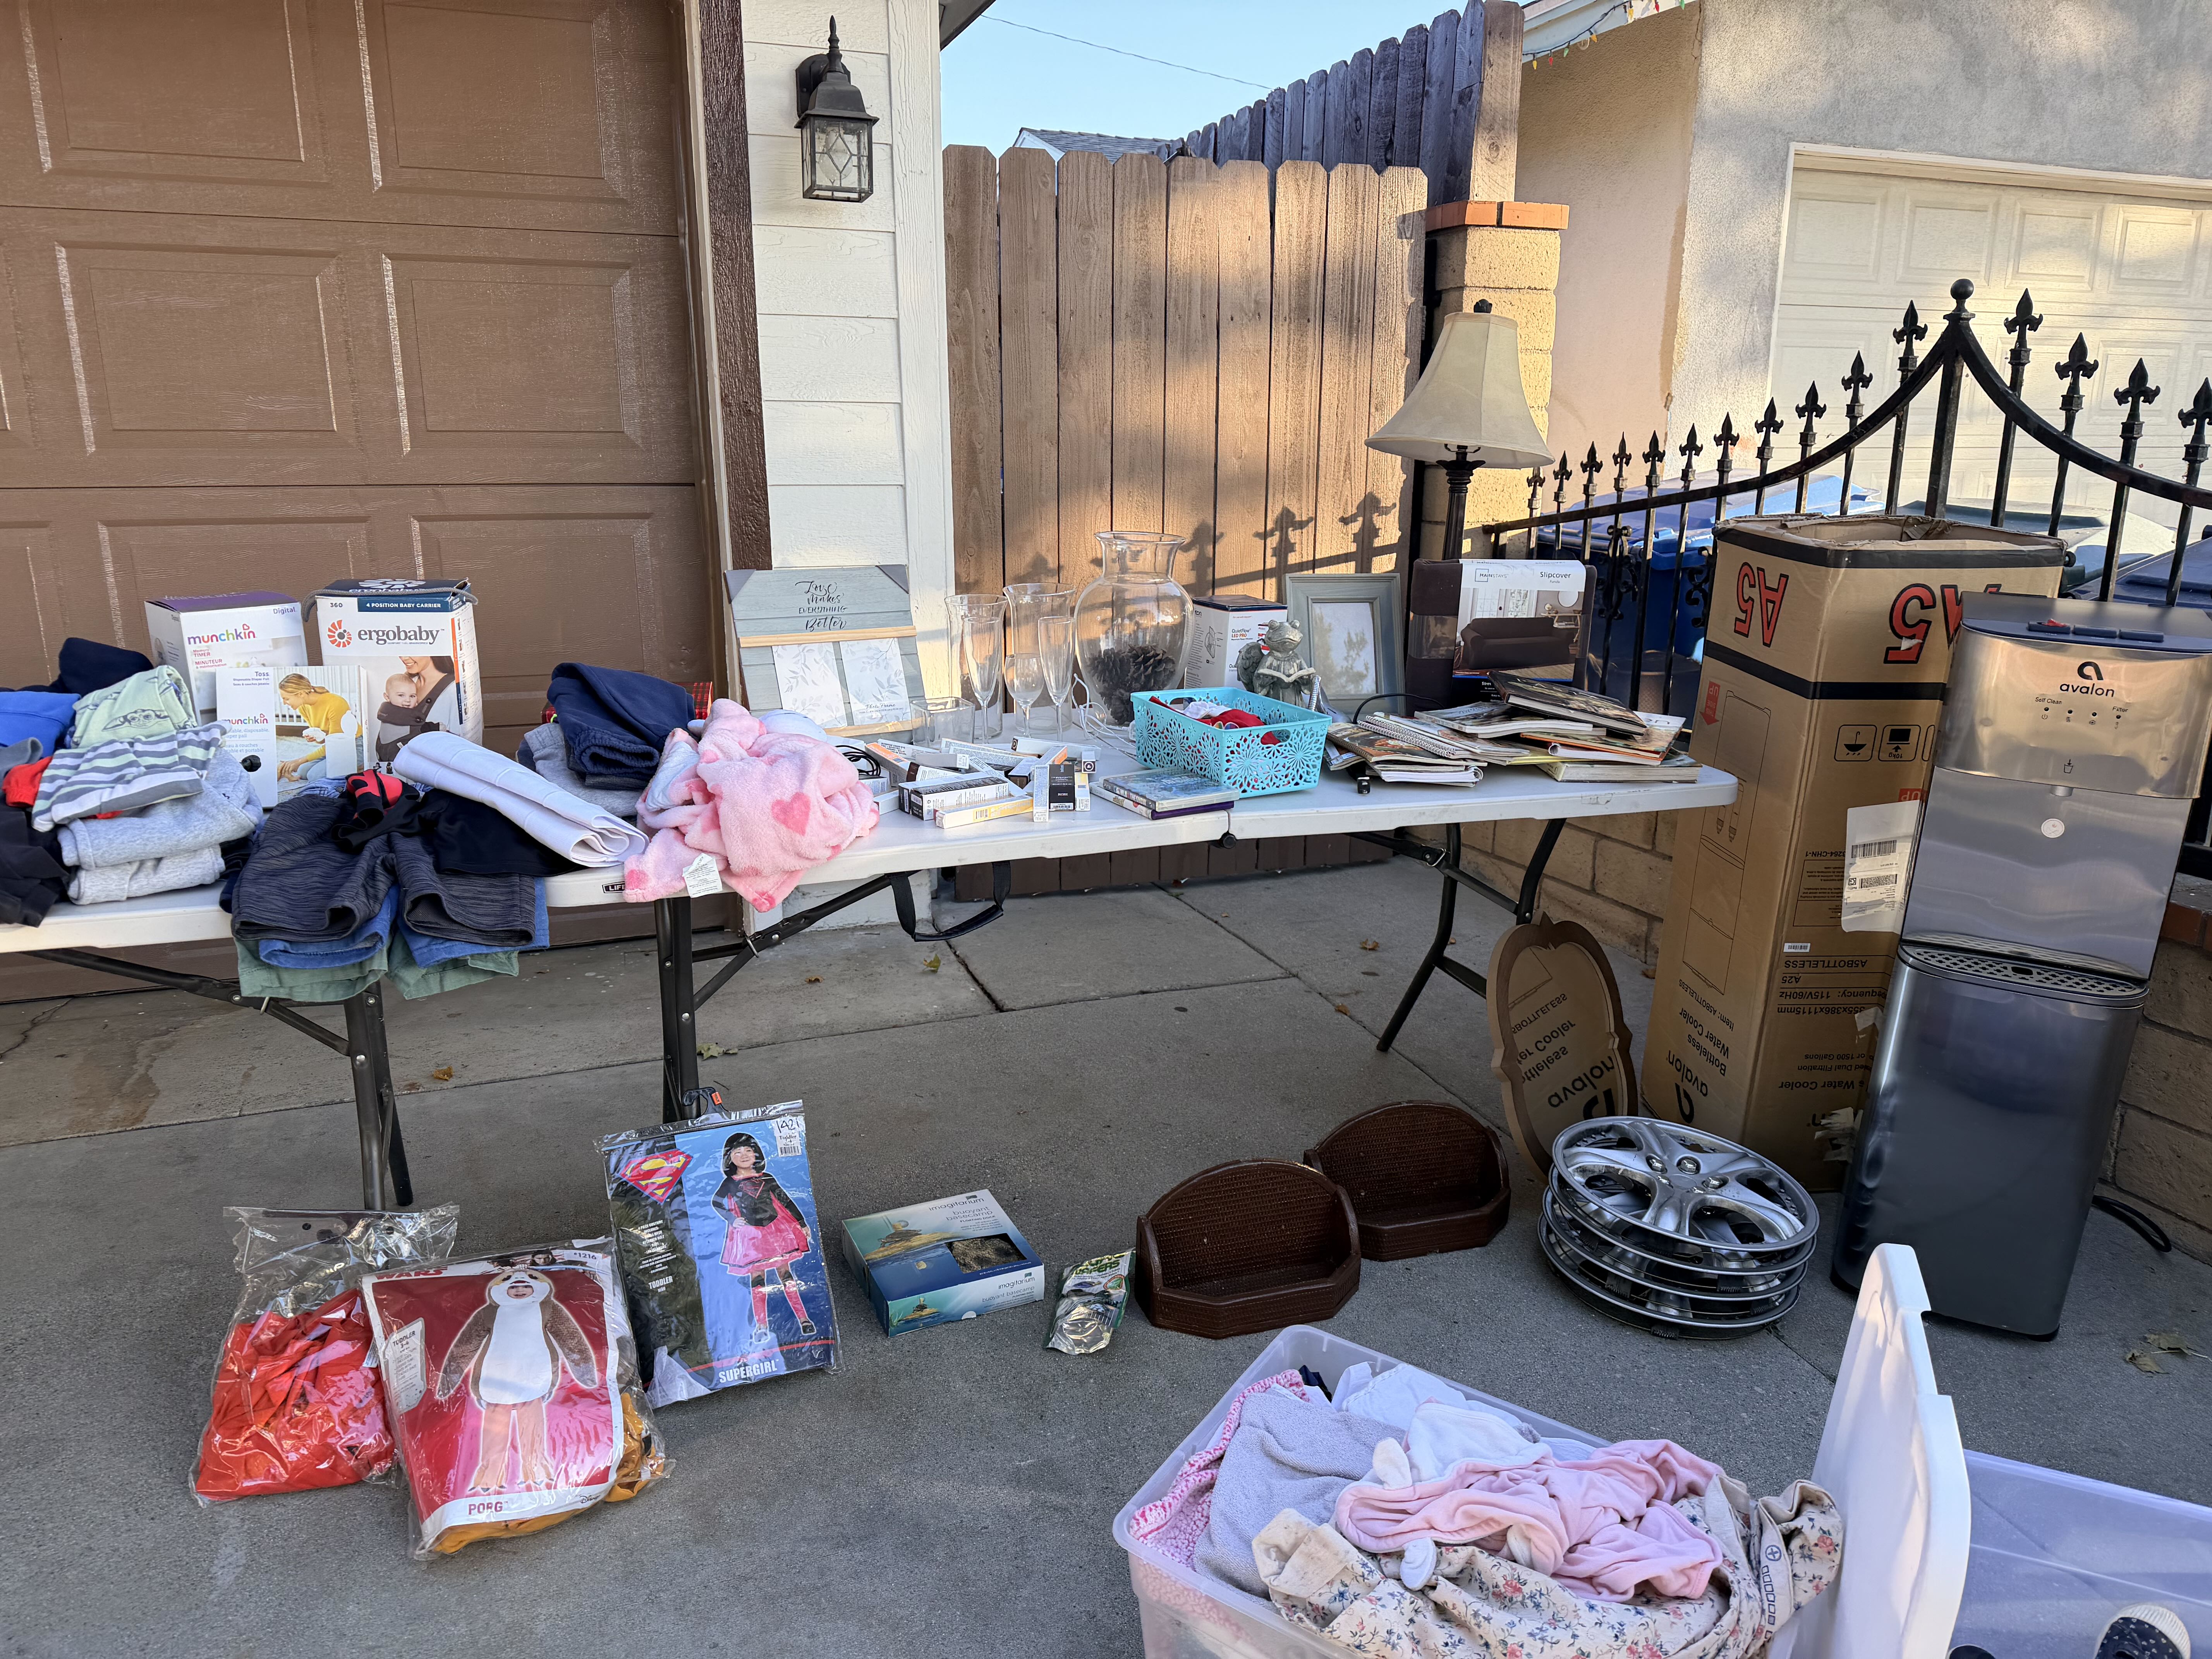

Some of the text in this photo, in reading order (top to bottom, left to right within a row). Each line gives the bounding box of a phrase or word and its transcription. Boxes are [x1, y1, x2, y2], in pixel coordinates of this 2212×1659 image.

[273, 606, 296, 615] Digital
[1733, 562, 1789, 647] A5
[187, 623, 256, 644] munchkin
[358, 626, 440, 645] ergobaby
[1710, 685, 1719, 696] UP
[2060, 683, 2114, 697] avalon
[1784, 959, 1868, 968] A5BOTTLELESS
[1782, 975, 1801, 984] A25
[1779, 990, 1831, 999] 115V/60Hz
[1679, 979, 1734, 1032] Item: A5BOTTLELESS
[1680, 1008, 1729, 1059] Water Cooler
[1688, 1034, 1726, 1077] Bottleless
[1668, 1050, 1708, 1097] avalon
[1778, 1081, 1818, 1091] Cooler
[1821, 1080, 1855, 1090] Water
[929, 1198, 984, 1211] imagitarium
[953, 1206, 990, 1215] buoyant
[946, 1211, 993, 1221] basecamp
[649, 1276, 673, 1289] TODDLER
[998, 1277, 1035, 1289] imagitarium
[982, 1293, 1005, 1302] buoyant
[1006, 1286, 1034, 1296] basecamp
[392, 1331, 416, 1347] TODDLER
[718, 1360, 778, 1383] SUPERGIRL
[468, 1501, 503, 1515] PORG
